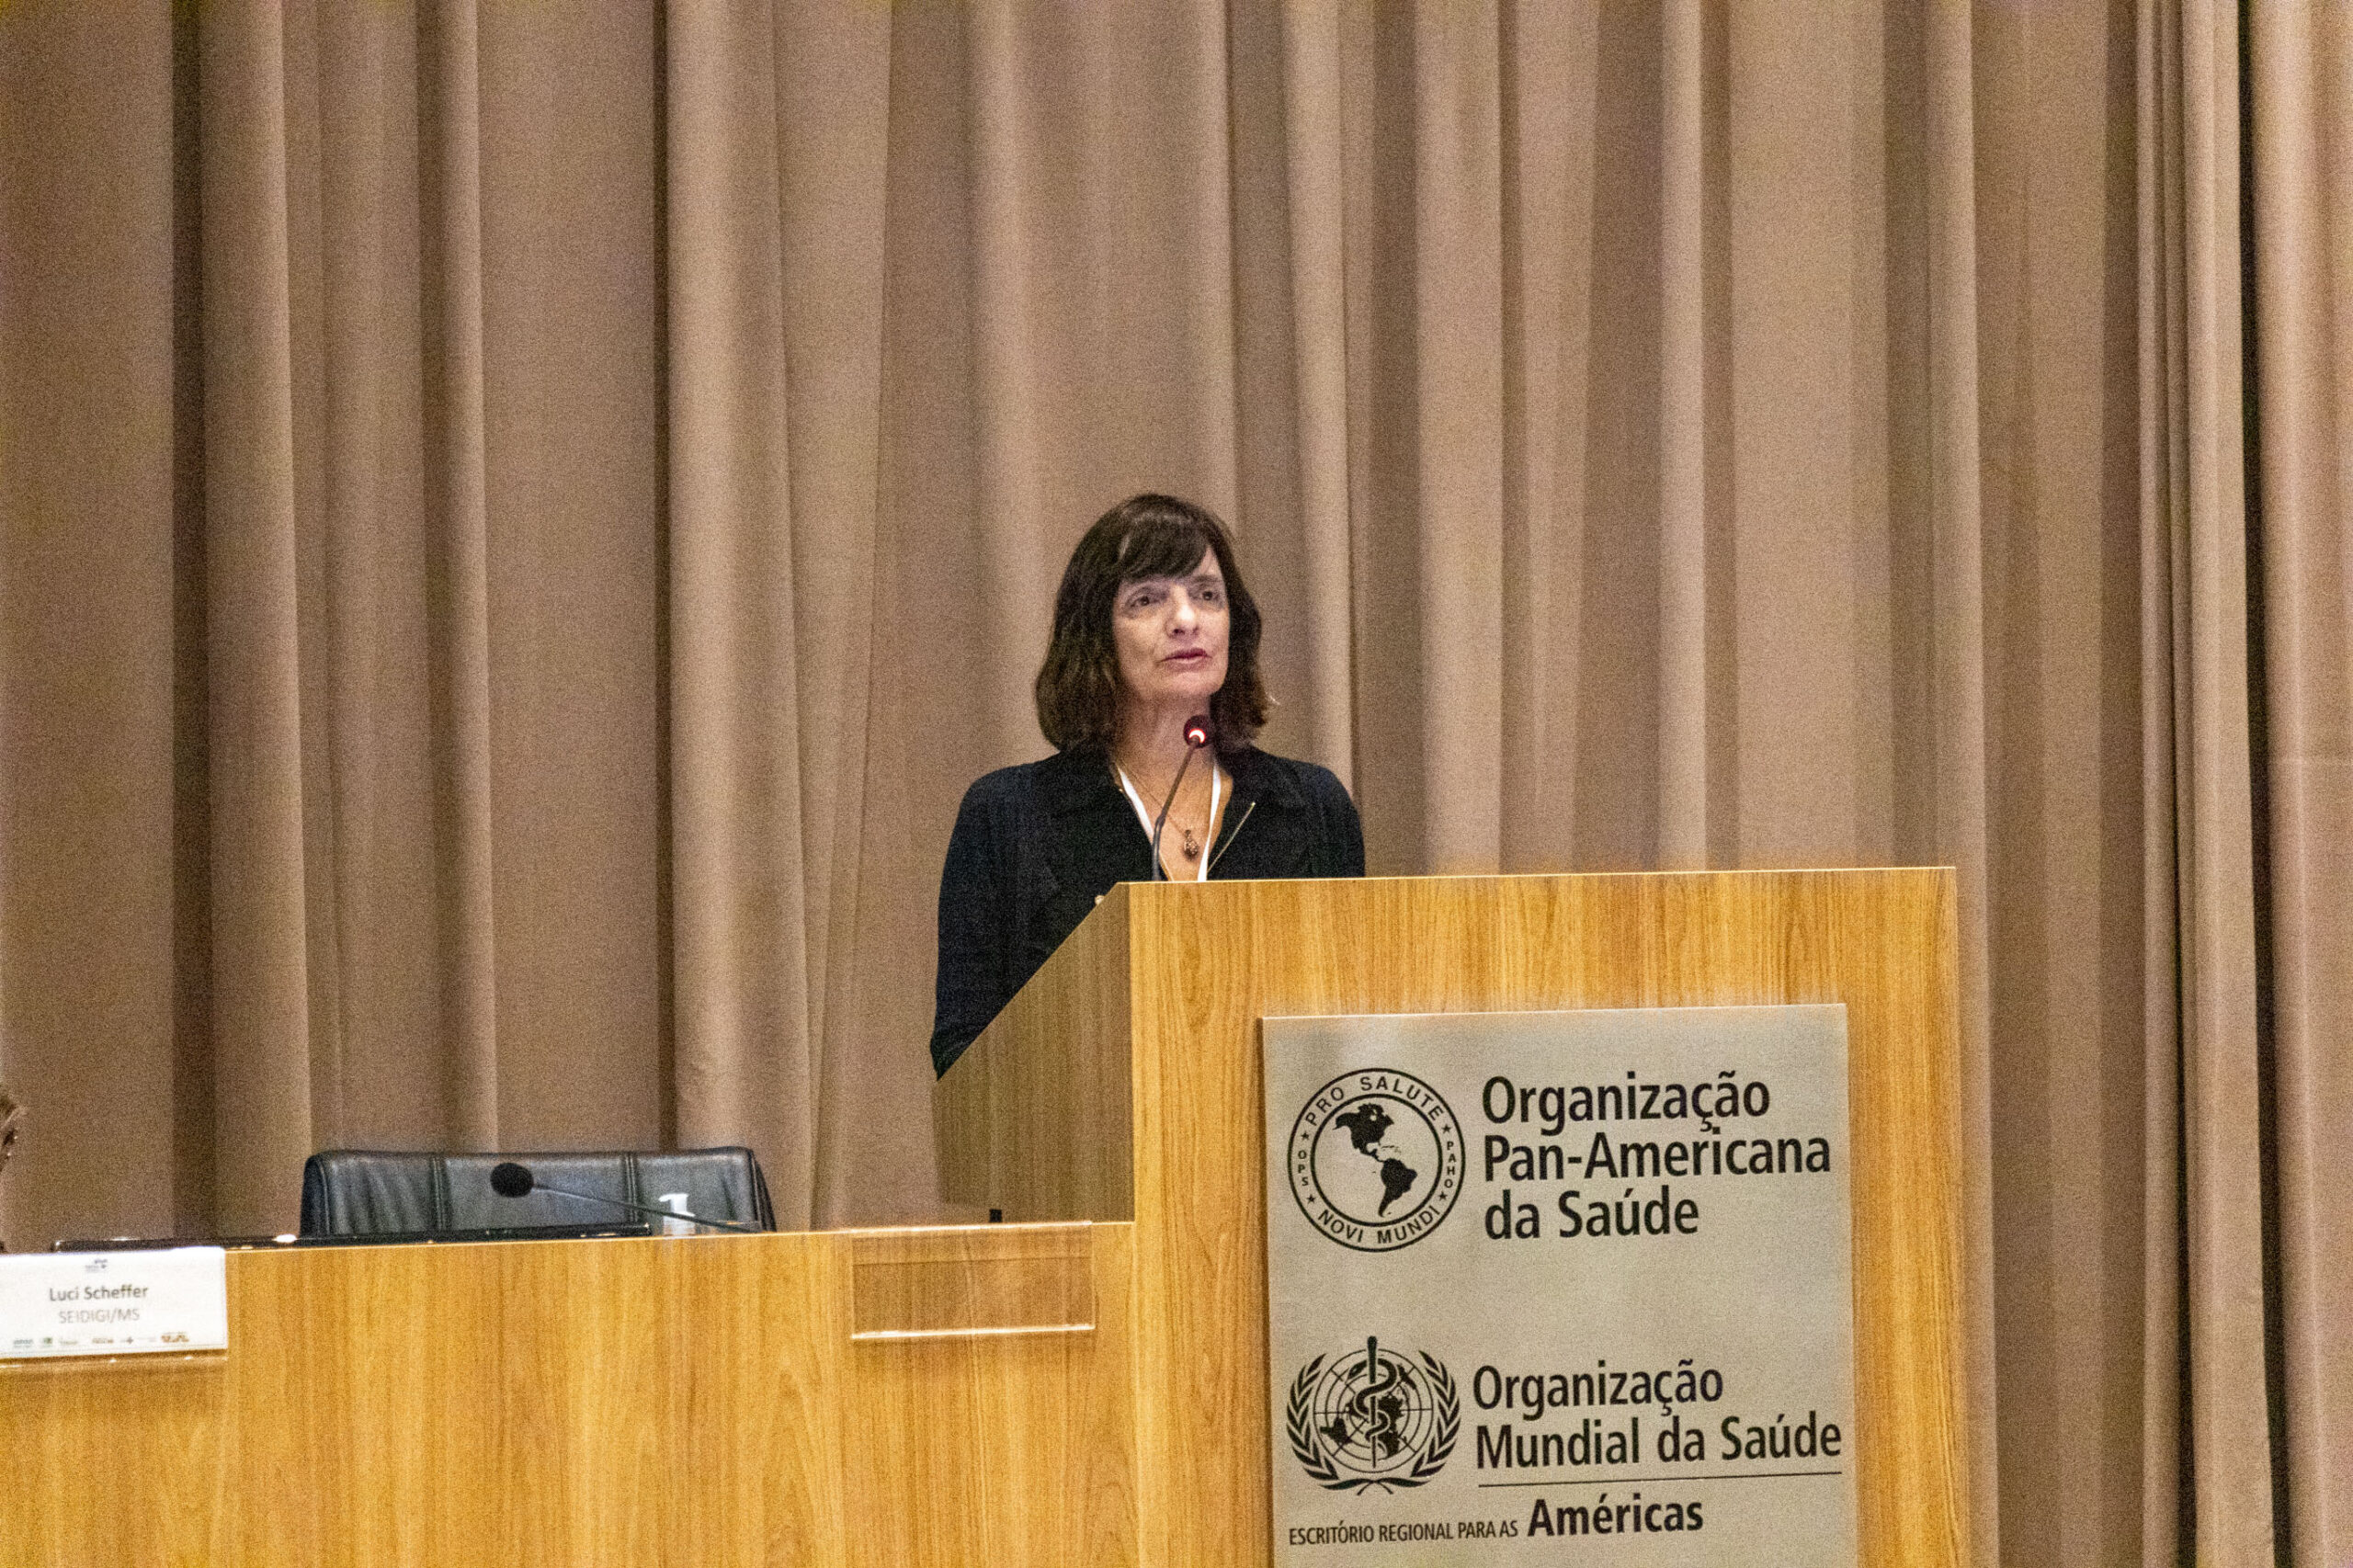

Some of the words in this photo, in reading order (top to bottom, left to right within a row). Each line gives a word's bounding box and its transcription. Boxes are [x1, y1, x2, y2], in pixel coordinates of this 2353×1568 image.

[1305, 1086, 1345, 1127] PRO
[1359, 1076, 1444, 1120] SALUTE
[1482, 1070, 1771, 1137] Organização
[1297, 1150, 1310, 1187] OPS
[1446, 1141, 1456, 1188] PAHO
[1483, 1126, 1831, 1182] Pan-Americana
[1317, 1210, 1364, 1243] NOVI
[1378, 1205, 1440, 1244] MUNDI
[1484, 1189, 1540, 1240] da
[1558, 1185, 1699, 1238] Saúde
[50, 1286, 79, 1301] Luci
[84, 1284, 149, 1301] Scheffer
[1473, 1359, 1723, 1422] Organização
[1476, 1417, 1641, 1470] Mundial
[1657, 1415, 1706, 1464] da
[1721, 1411, 1842, 1461] Saúde
[1289, 1520, 1375, 1546] ESCRITÓRIO
[1378, 1523, 1454, 1542] REGIONAL
[1458, 1521, 1497, 1540] PARA
[1498, 1520, 1518, 1538] AS
[1528, 1494, 1704, 1537] Américas
